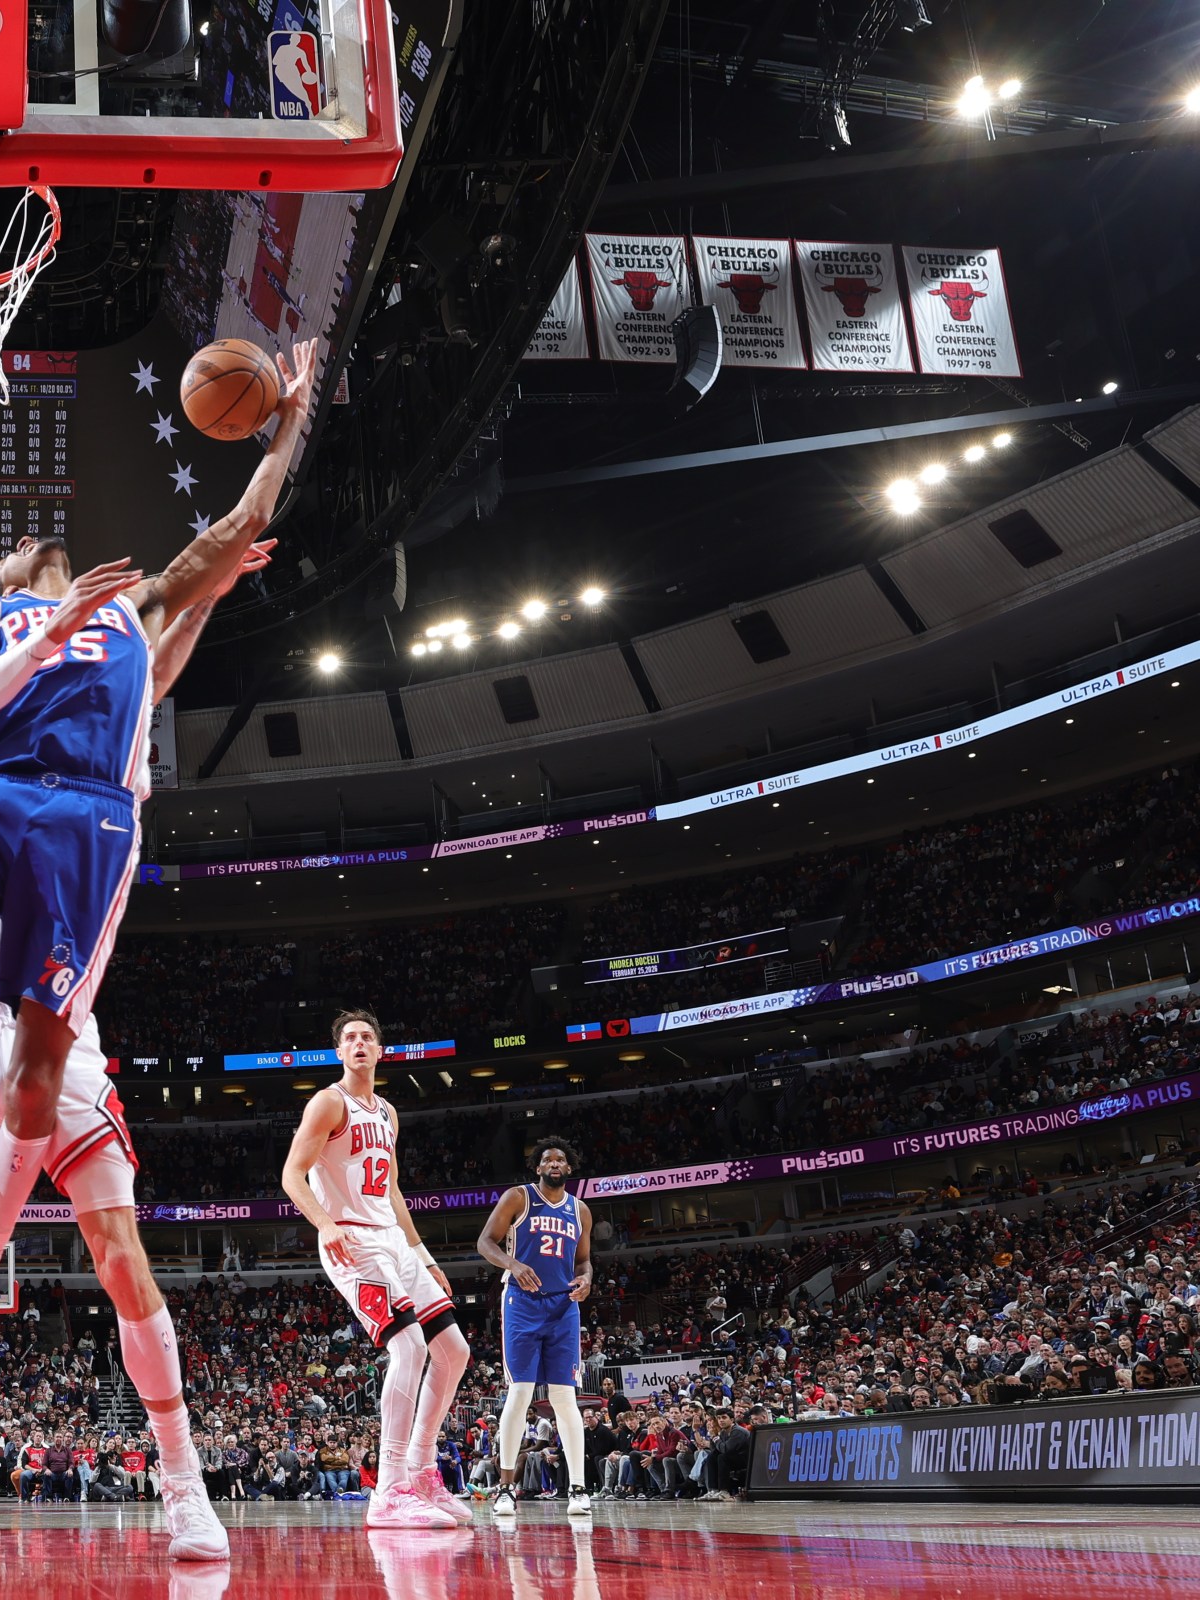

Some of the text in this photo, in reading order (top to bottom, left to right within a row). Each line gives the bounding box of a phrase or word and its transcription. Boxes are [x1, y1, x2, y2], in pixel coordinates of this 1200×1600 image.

[411, 41, 432, 82] 13/36
[280, 101, 303, 117] NBA
[600, 243, 672, 256] CHICAGO
[707, 245, 778, 258] CHICAGO
[614, 258, 664, 268] BULLS
[721, 260, 770, 272] BULLS
[917, 253, 987, 267] CHICAGO
[930, 268, 980, 279] BULLS
[943, 324, 984, 334] EASTERN
[935, 335, 996, 346] CONFERENCE
[13, 354, 31, 370] 94
[937, 347, 996, 358] CHAMPIONS
[1061, 658, 1166, 703] ULTRA SUITE
[881, 726, 980, 761] ULTRA SUITE
[710, 774, 800, 805] ULTRA SUITE
[584, 812, 646, 831] Plus500
[443, 831, 537, 852] DOWNLOAD THE APP
[207, 851, 407, 875] IT'S FUTURES TRADING A PLUS
[944, 922, 1112, 975] IT'S FUTURES TRADING
[609, 955, 659, 969] ANDREA BOCELLI
[38, 957, 74, 997] 76
[612, 968, 636, 977] FEBRUARY
[841, 972, 919, 996] Plus500
[672, 1005, 737, 1024] DOWNLOAD
[405, 1043, 425, 1051] 76ERS
[494, 1035, 526, 1048] BLOCKS
[257, 1054, 325, 1065] BMO CLUB
[1132, 1081, 1192, 1110] A PLUS
[893, 1110, 1078, 1155] IT'S FUTURES TRADING
[782, 1149, 864, 1173] Plus500
[362, 1157, 390, 1197] 12
[593, 1169, 719, 1193] DOWNLOAD THE APP
[445, 1194, 485, 1207] WITH
[529, 1215, 576, 1239] PHILA
[540, 1235, 565, 1257] 21
[769, 1442, 780, 1470] GS
[789, 1412, 1200, 1482] GOOD SPORTS WITH KEVIN HART & KENAN THOM
